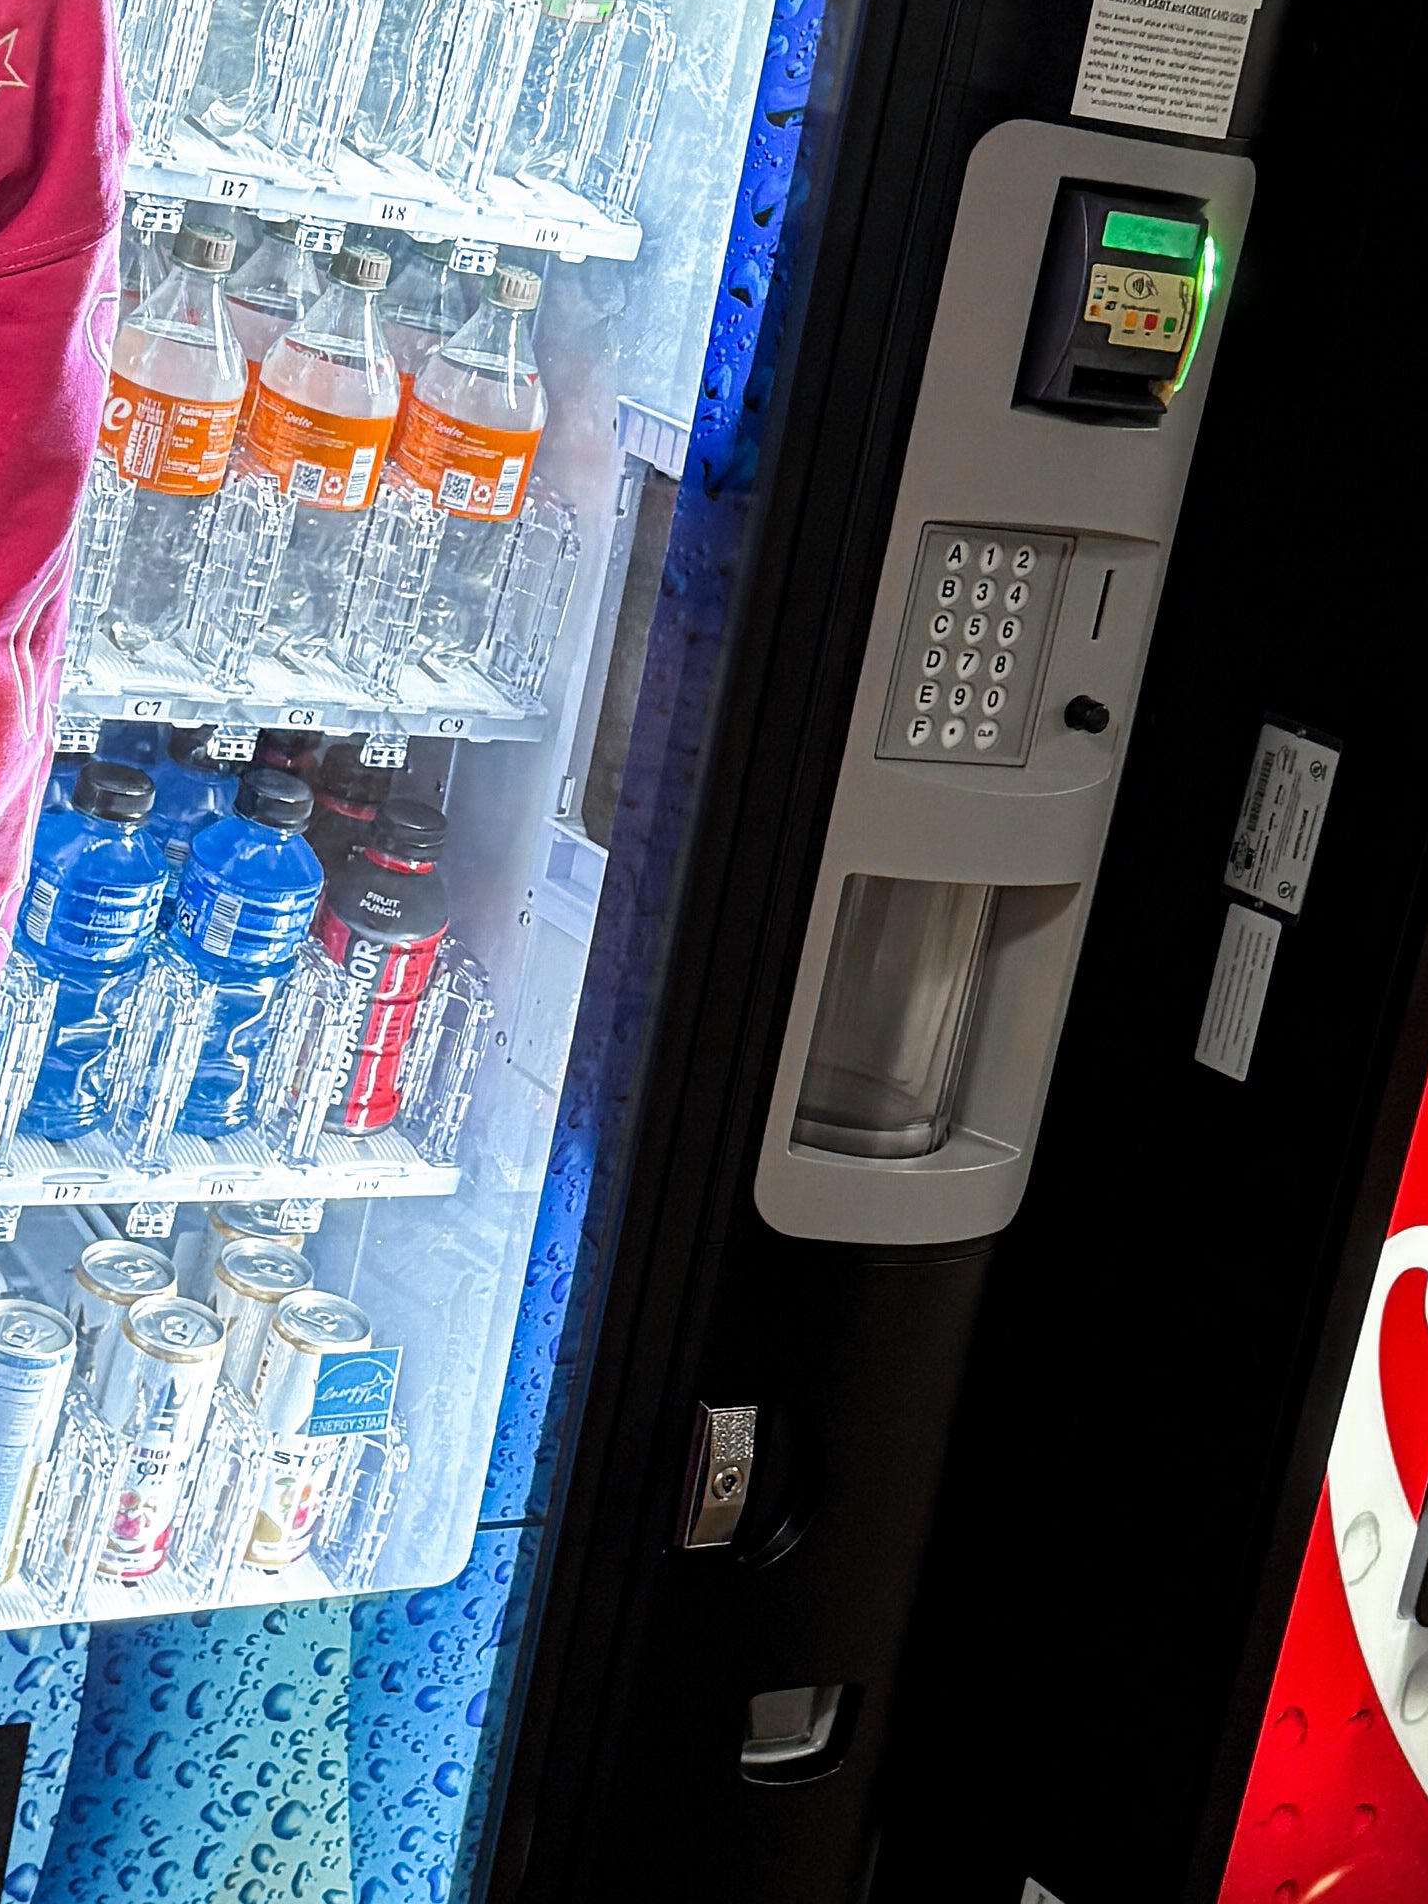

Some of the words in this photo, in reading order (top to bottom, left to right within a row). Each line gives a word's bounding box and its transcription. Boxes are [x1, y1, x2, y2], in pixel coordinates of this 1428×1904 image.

[948, 544, 962, 563] A
[987, 547, 995, 566] 1
[1016, 550, 1030, 569] 2
[941, 580, 956, 598] B
[977, 583, 988, 601] 3
[1010, 586, 1021, 604] 4
[934, 615, 949, 634] C
[969, 618, 981, 636] 5
[1002, 621, 1014, 639] 6
[926, 650, 941, 669] D
[962, 653, 974, 670] 7
[994, 655, 1006, 673] 8
[919, 685, 934, 703] E
[954, 688, 966, 705] 9
[987, 690, 999, 708] 0
[133, 700, 161, 717] C7
[287, 709, 314, 725] C8
[438, 717, 465, 734] C9
[912, 720, 927, 738] F
[365, 890, 401, 908] FRUIT
[358, 899, 402, 919] PUNCH
[312, 1418, 357, 1433] ENERGY
[357, 1416, 386, 1430] STAR
